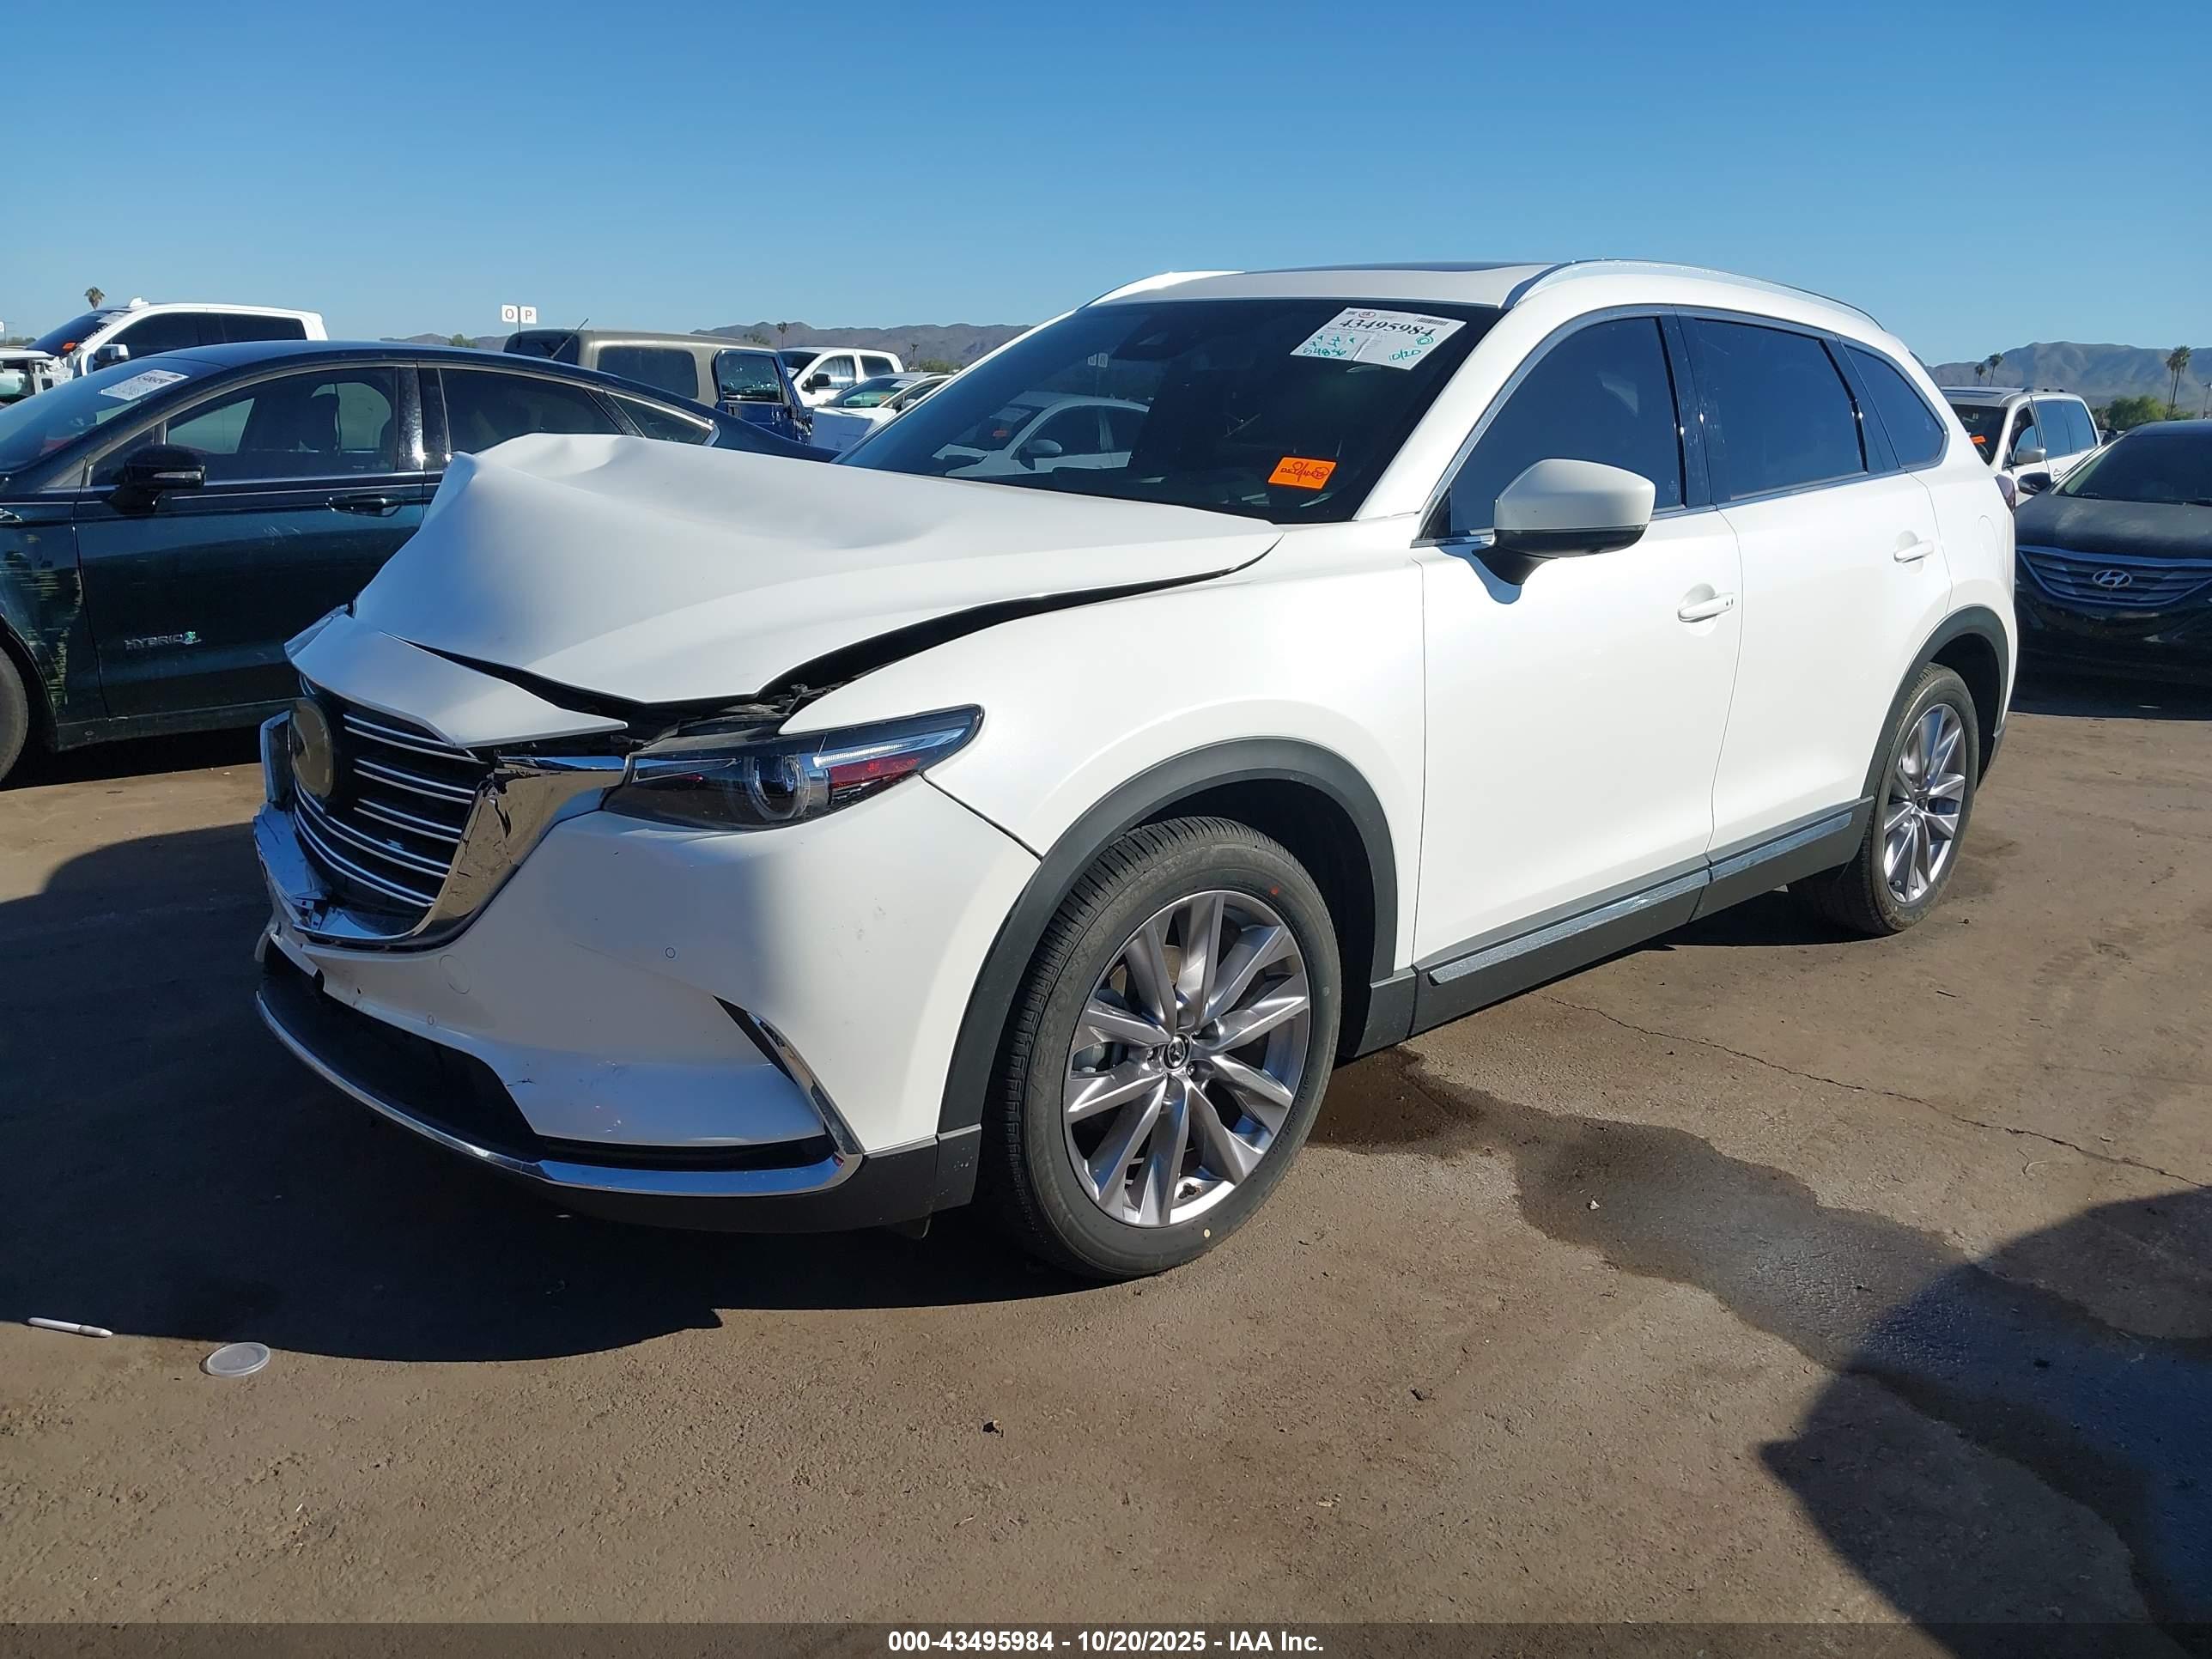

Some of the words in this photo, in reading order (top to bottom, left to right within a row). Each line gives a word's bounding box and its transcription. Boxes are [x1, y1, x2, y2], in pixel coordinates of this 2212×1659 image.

[525, 310, 532, 320] P
[1339, 319, 1437, 336] 43495984
[124, 635, 184, 650] HYBRID
